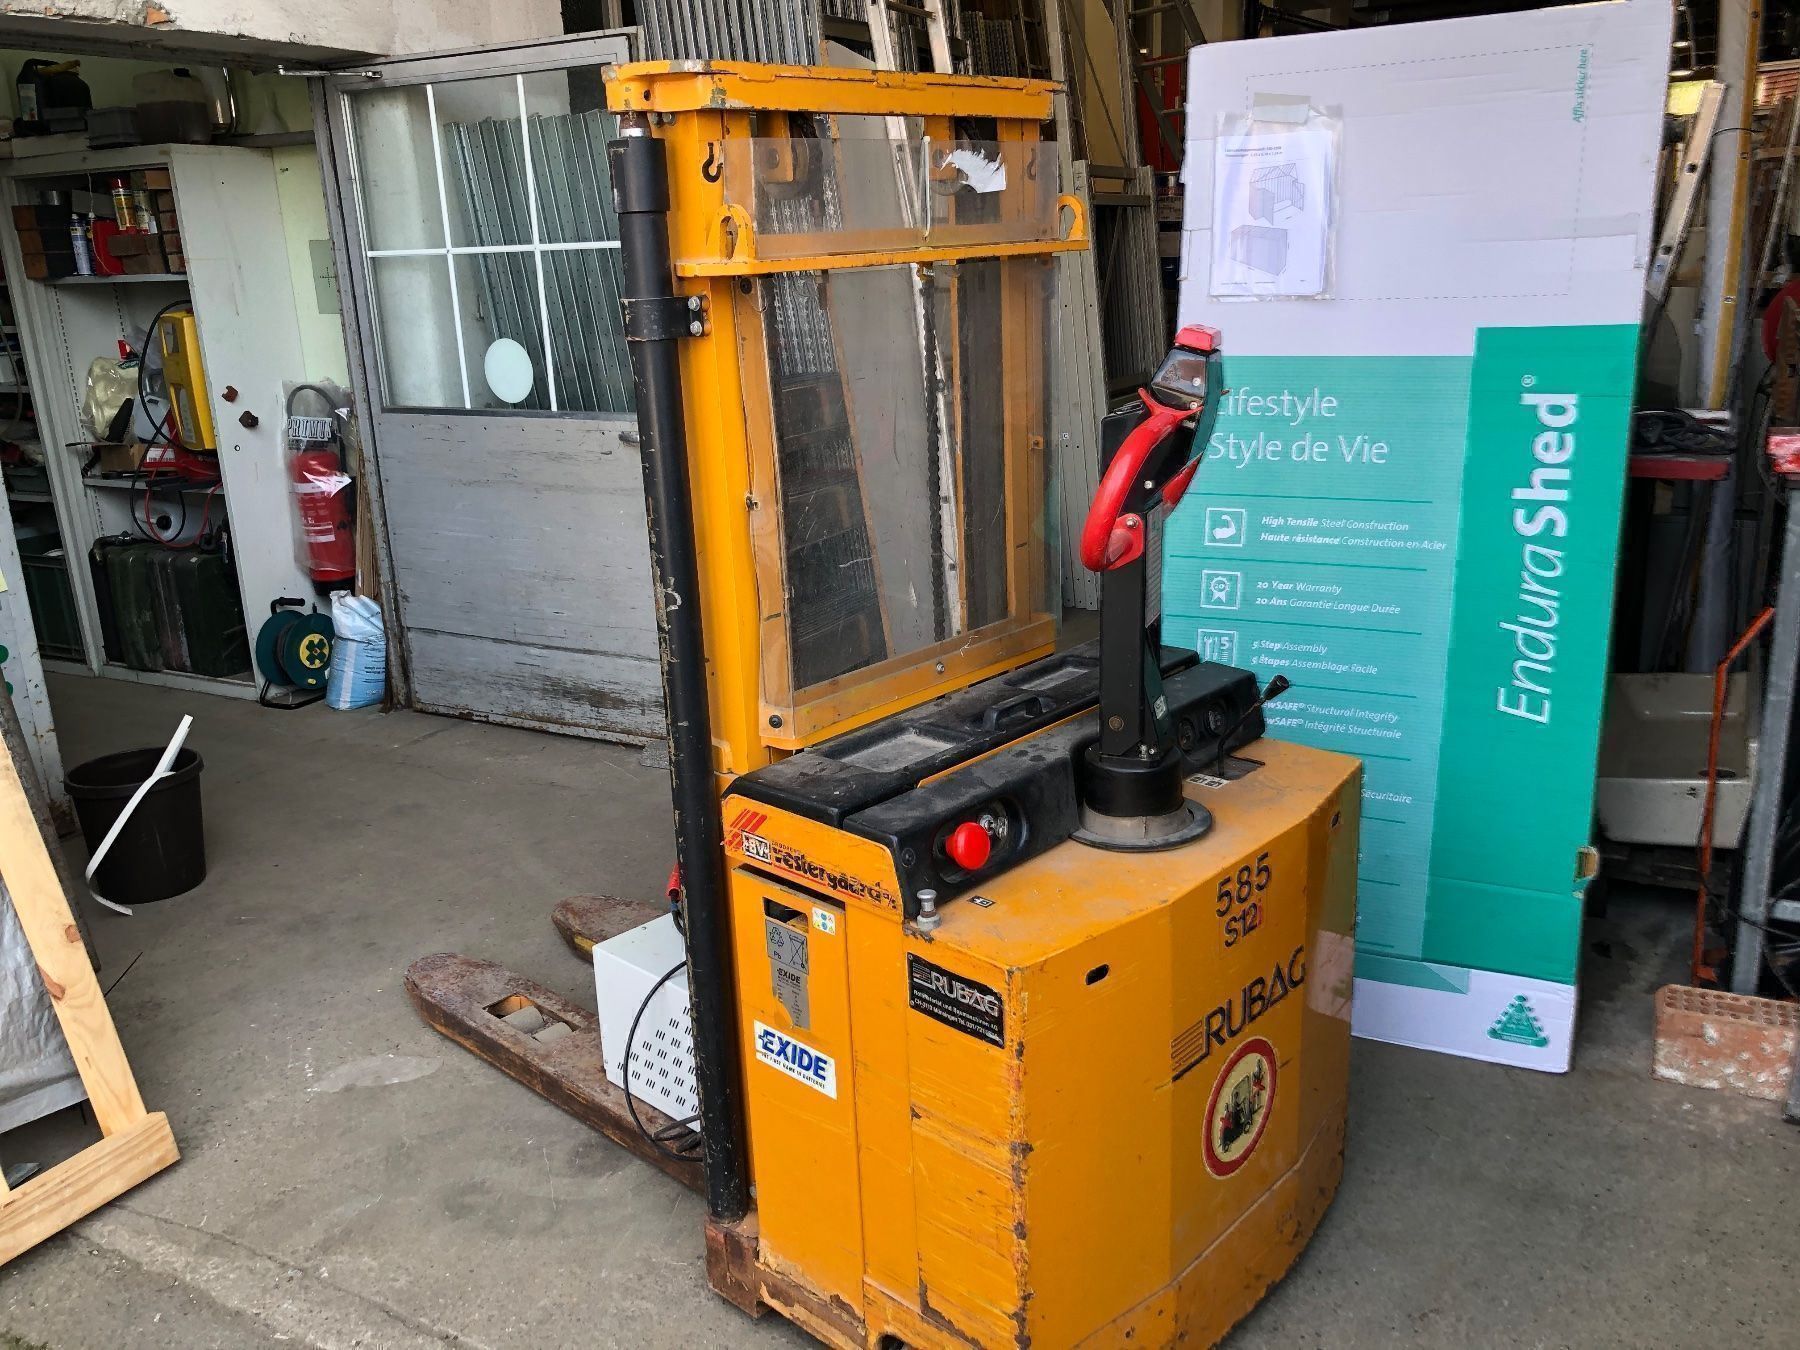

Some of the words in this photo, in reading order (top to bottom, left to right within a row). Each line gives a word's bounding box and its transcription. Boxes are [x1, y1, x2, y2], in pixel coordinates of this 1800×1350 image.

[1577, 49, 1587, 70] here
[1574, 71, 1586, 100] sticker
[1572, 101, 1584, 123] Affix
[287, 416, 333, 441] PRIMUS
[1207, 432, 1283, 469] Style
[1290, 431, 1330, 462] de
[1337, 435, 1389, 465] Vie
[1261, 516, 1285, 527] High
[1286, 517, 1319, 528] Tensile
[1320, 518, 1345, 529] Steel
[1346, 519, 1409, 532] Construction
[1260, 532, 1290, 543] Haute
[1292, 533, 1340, 546] résistance
[1341, 536, 1405, 549] Construction
[1406, 541, 1419, 549] en
[1420, 539, 1447, 551] Acier
[1256, 581, 1269, 589] 20
[1271, 581, 1294, 591] Year
[1295, 582, 1342, 596] Warranty
[1269, 597, 1288, 606] Ans
[1289, 598, 1332, 610] Garantie
[1333, 601, 1369, 613] Longue
[1370, 603, 1401, 615] Durée
[1220, 636, 1230, 650] 5
[1251, 640, 1258, 650] 5
[1259, 640, 1282, 652] Step
[1283, 641, 1328, 656] Assembly
[1250, 656, 1258, 665] 5
[1258, 653, 1290, 667] Étapes
[1291, 658, 1349, 674] Assemblage
[1350, 664, 1378, 675] Facile
[1306, 704, 1355, 717] Structural
[1355, 708, 1399, 724] Integrity
[1304, 720, 1346, 733] Intégrité
[1347, 723, 1402, 739] Structurale
[1216, 852, 1271, 918] 585
[772, 950, 782, 960] Pb
[776, 967, 801, 984] EXIDE
[1201, 944, 1306, 1054] RUBAG
[758, 1028, 828, 1082] EXIDE
